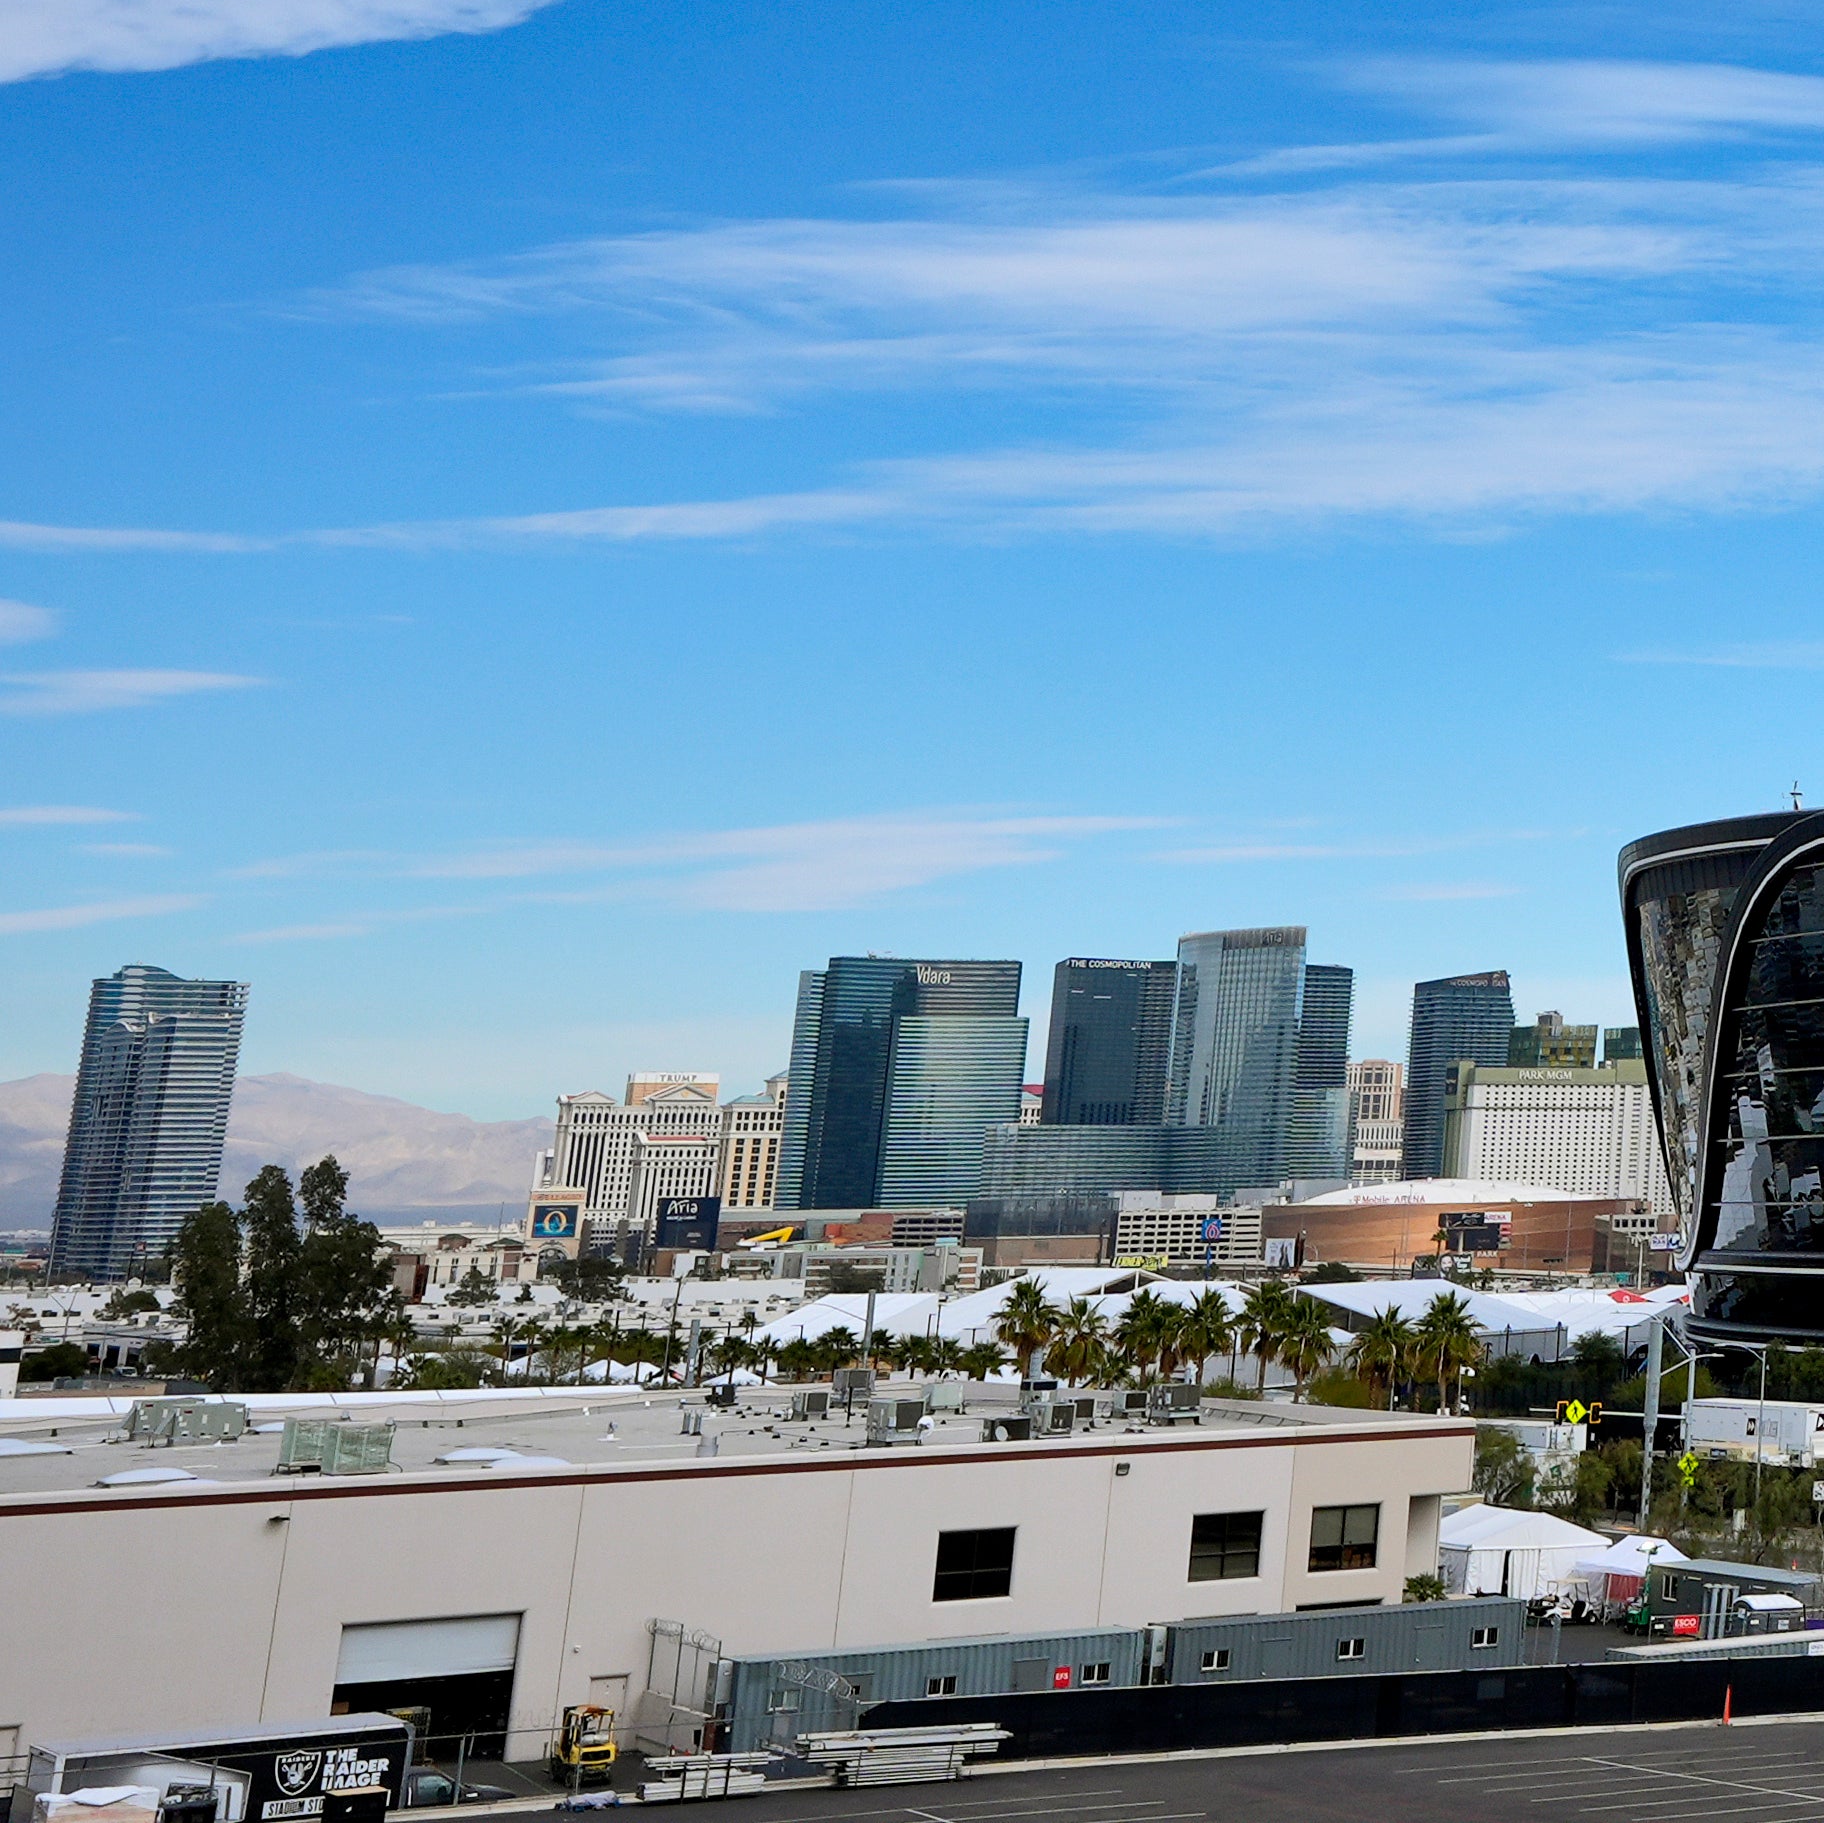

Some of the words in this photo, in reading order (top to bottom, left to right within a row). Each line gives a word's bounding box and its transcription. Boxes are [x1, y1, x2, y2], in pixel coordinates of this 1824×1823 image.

[1070, 960, 1087, 968] THE
[1088, 960, 1151, 969] COSMOPOLITAN
[917, 965, 950, 984] Vdara
[660, 1074, 697, 1082] TRUMP
[1519, 1070, 1544, 1080] PARK
[1546, 1070, 1572, 1080] MGM
[1362, 1195, 1390, 1203] Mobile
[1394, 1195, 1426, 1203] ARENA
[667, 1200, 698, 1215] Aria
[326, 1748, 359, 1763] THE
[323, 1758, 390, 1776] RAIDER
[321, 1773, 381, 1791] IMAGE
